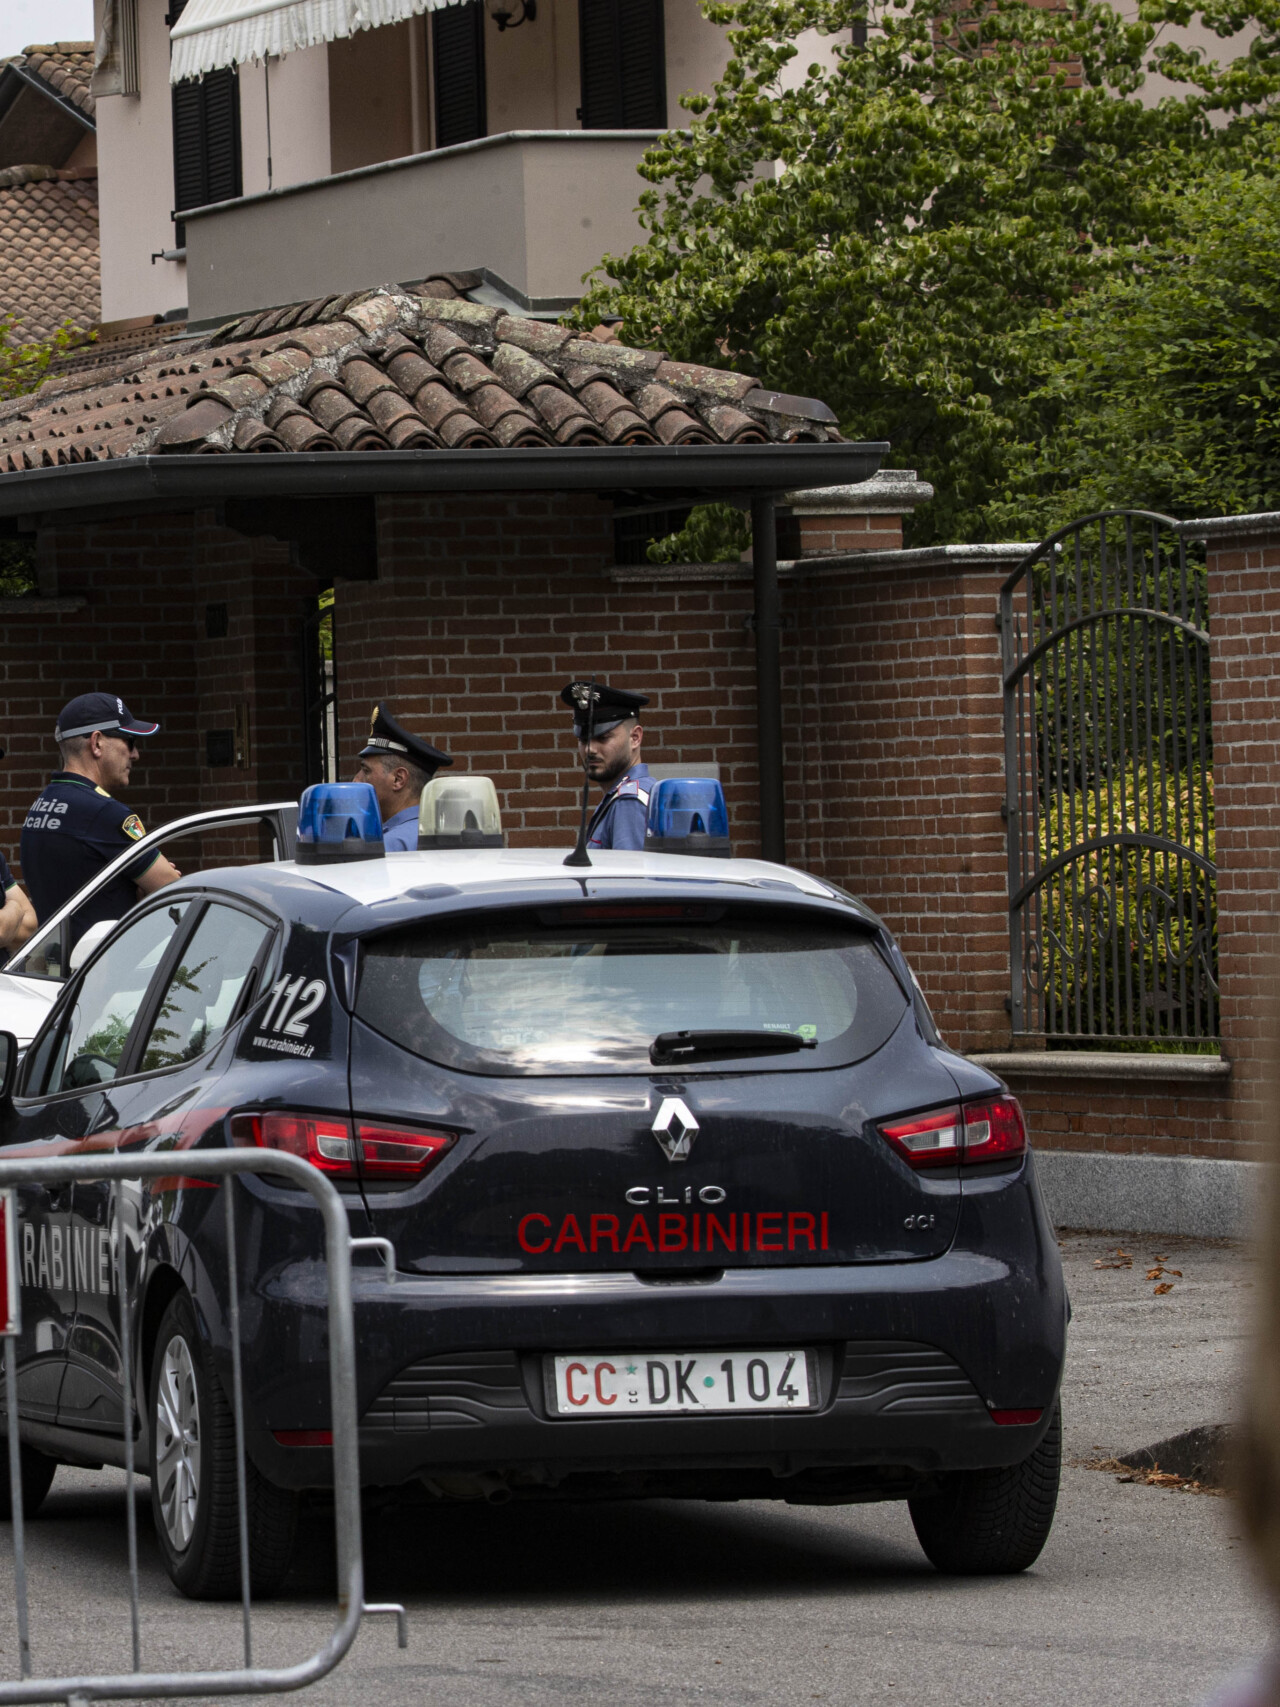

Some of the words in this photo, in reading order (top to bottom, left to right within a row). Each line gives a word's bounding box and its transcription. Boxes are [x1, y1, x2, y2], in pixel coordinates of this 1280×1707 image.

[260, 973, 327, 1038] 112
[252, 1036, 315, 1058] www.carabinieri.it
[625, 1185, 727, 1205] CLIO
[518, 1212, 829, 1253] CARABINIERI
[904, 1214, 935, 1229] dCi
[565, 1362, 618, 1406] CC
[646, 1360, 700, 1405] DK
[721, 1357, 799, 1402] 104
